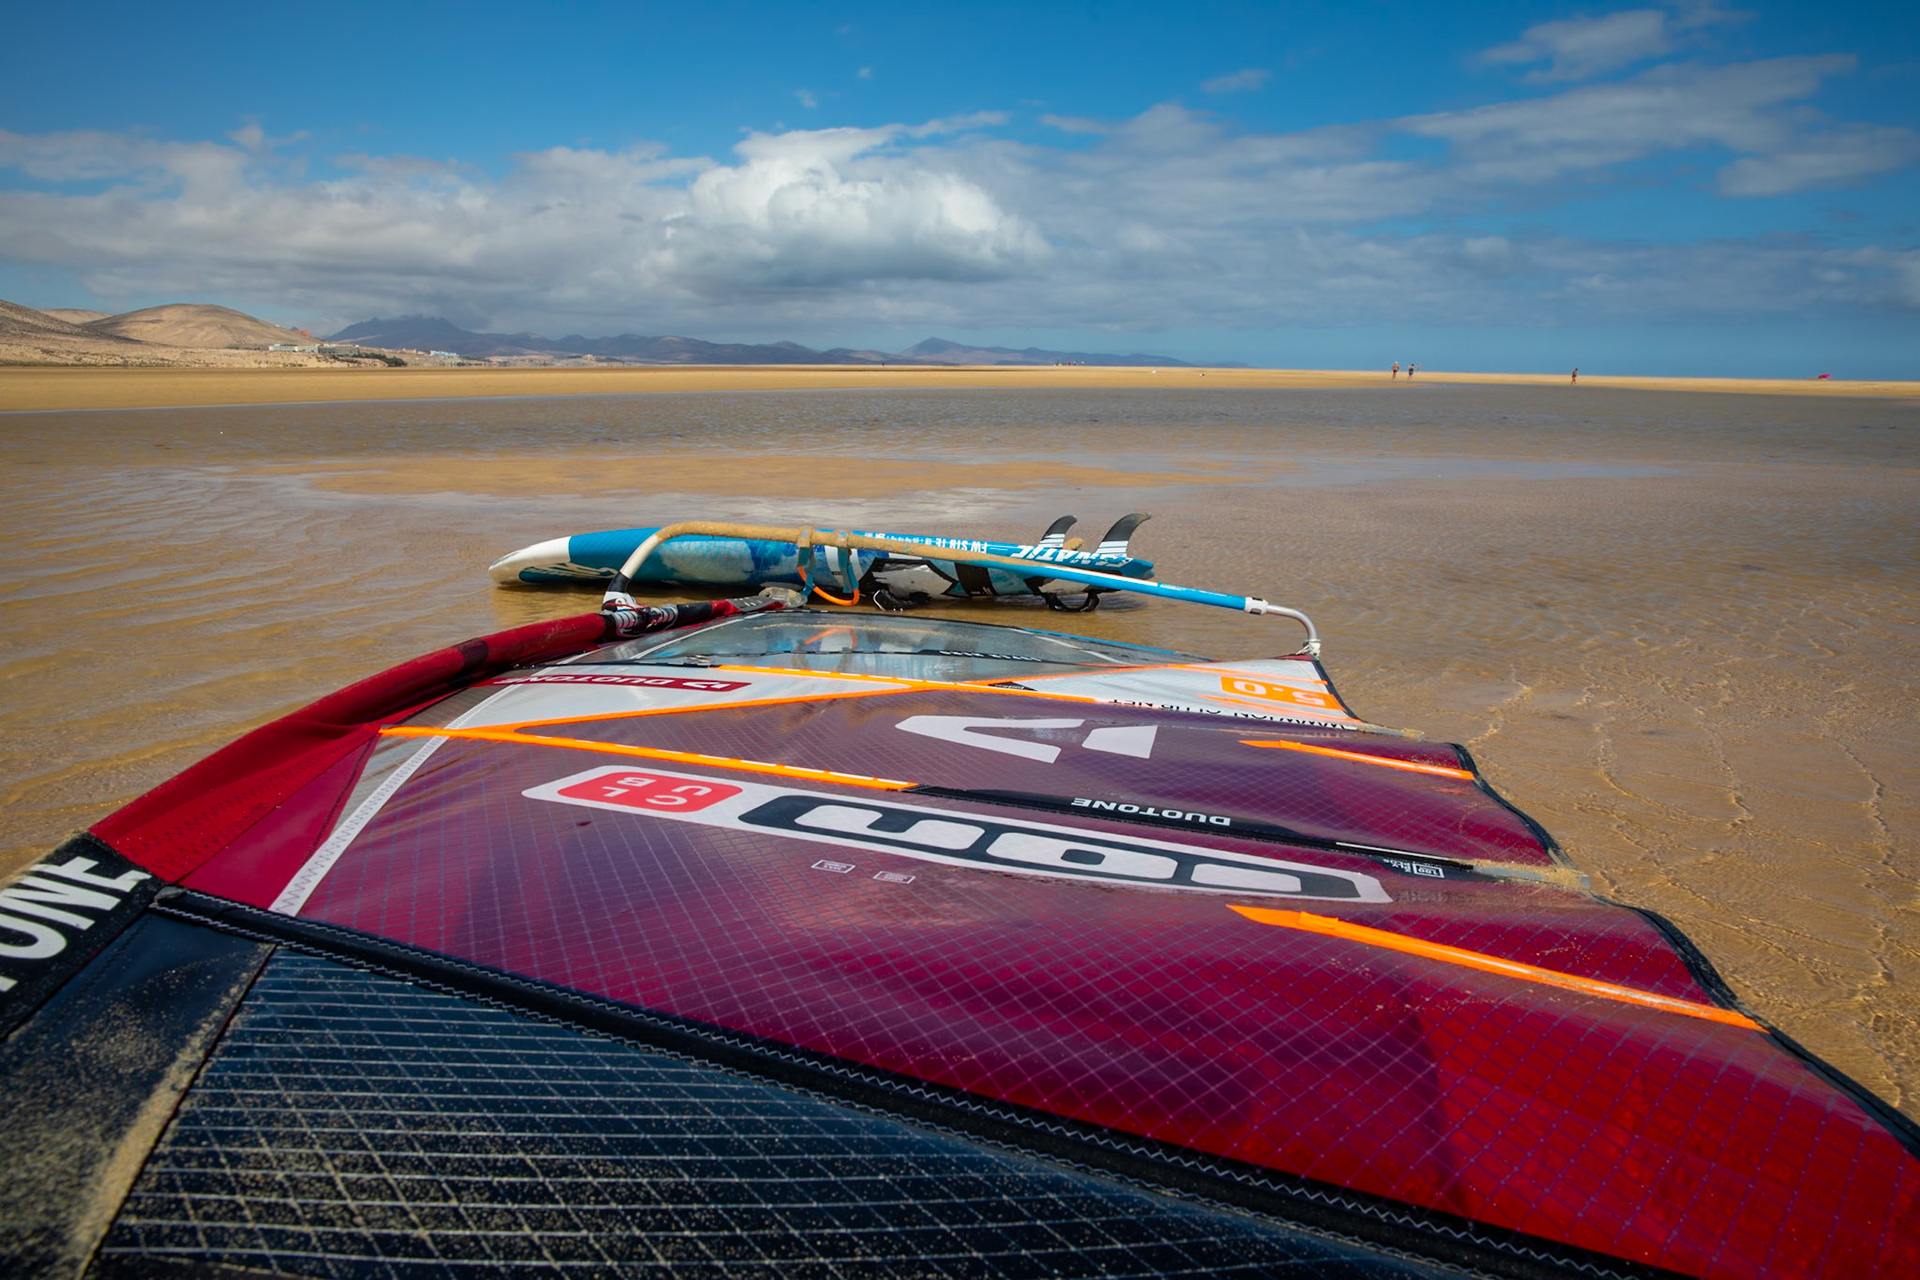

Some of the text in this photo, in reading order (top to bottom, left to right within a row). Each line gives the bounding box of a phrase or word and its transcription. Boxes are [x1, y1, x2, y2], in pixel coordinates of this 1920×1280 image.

[494, 675, 675, 686] DUOTONE
[1233, 680, 1325, 707] 5.0
[1071, 797, 1231, 826] DUOTONE
[0, 856, 152, 991] ONE
